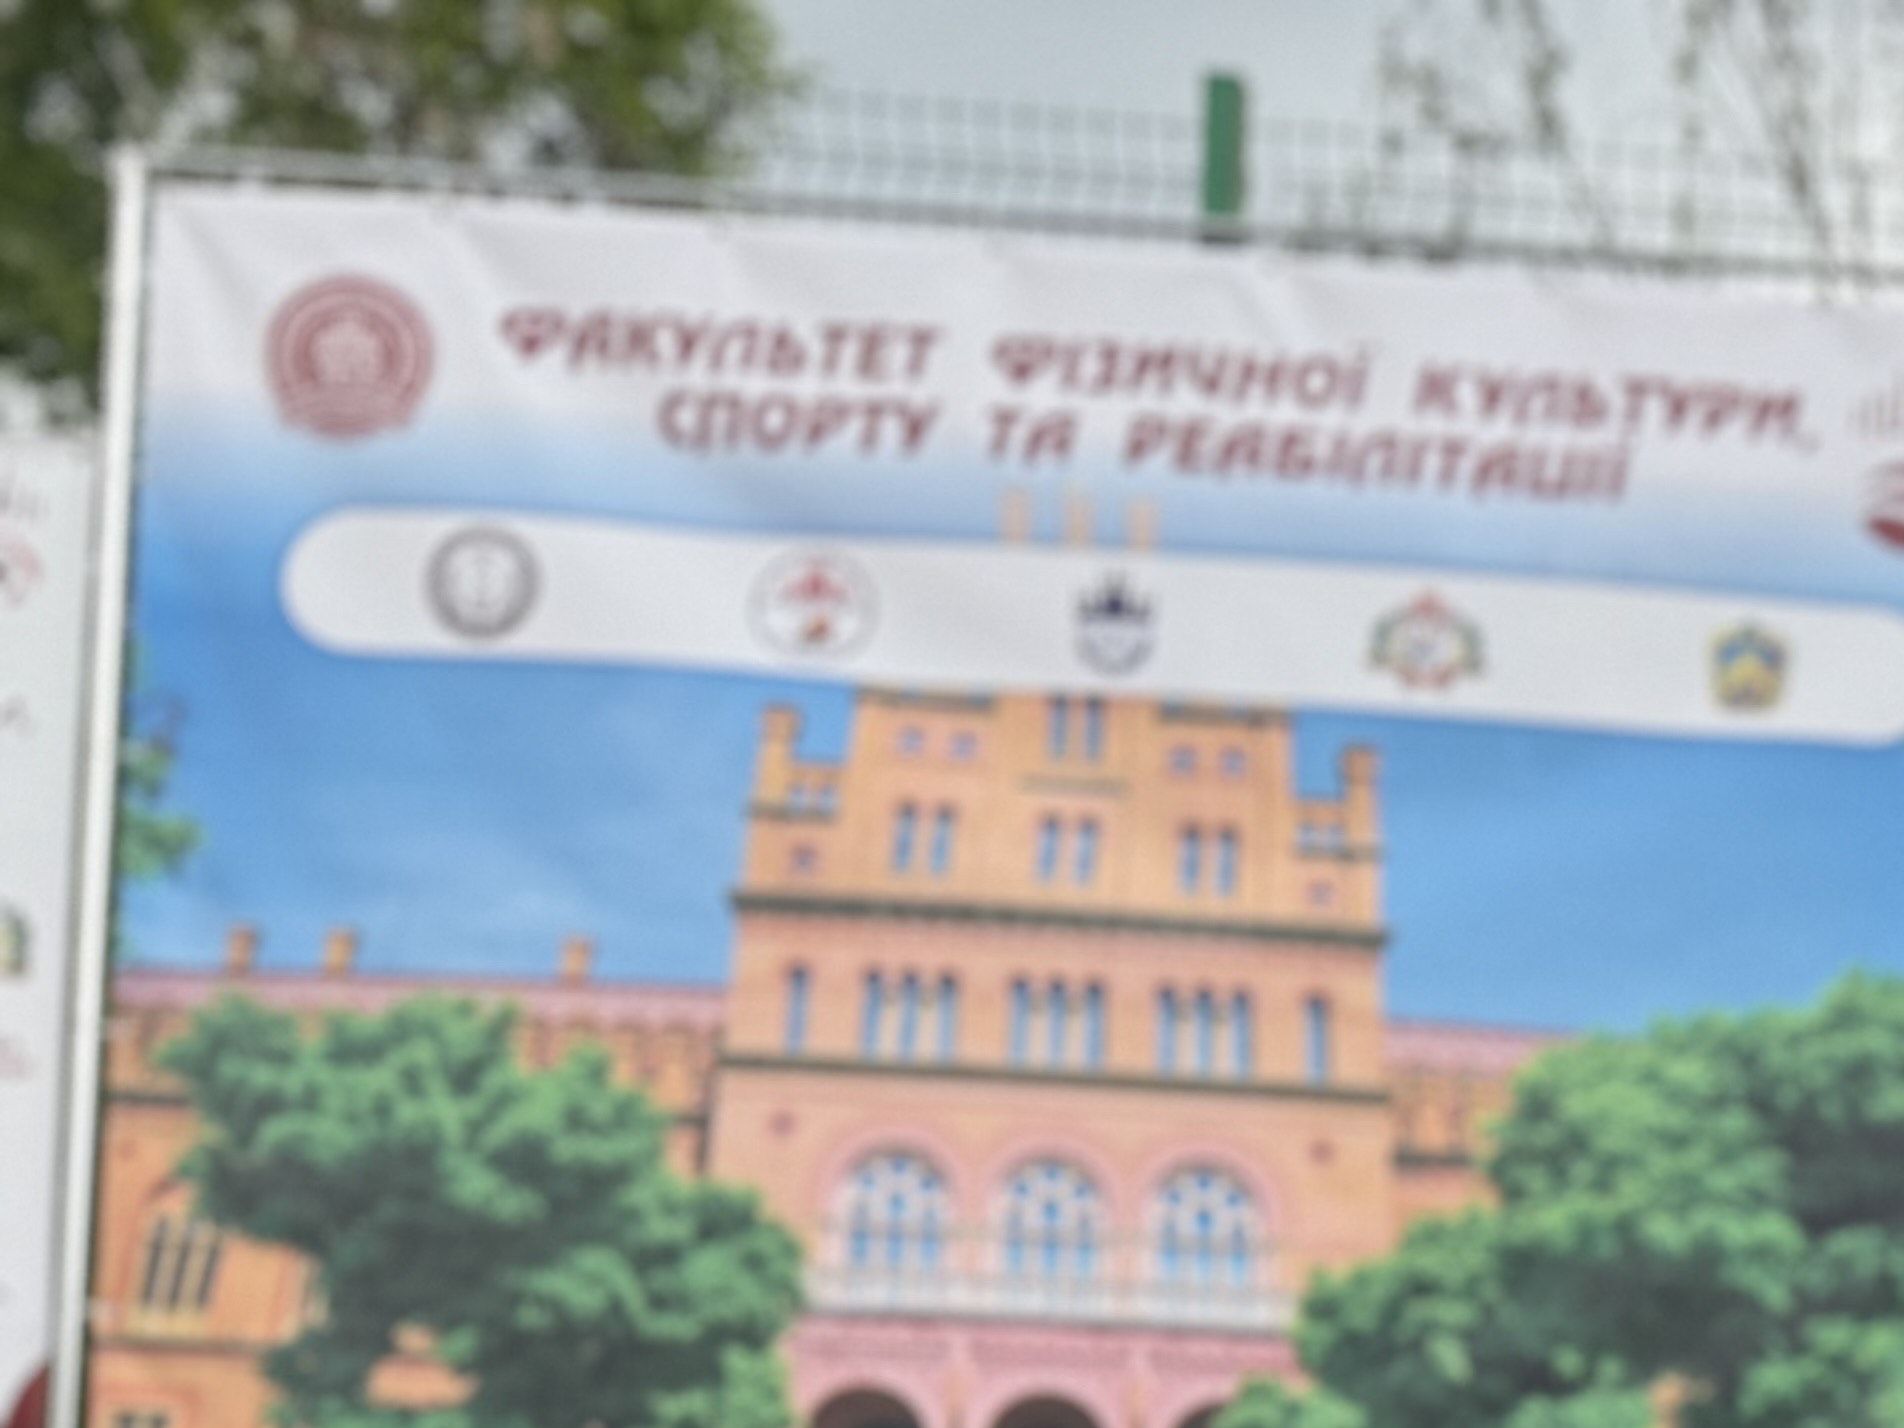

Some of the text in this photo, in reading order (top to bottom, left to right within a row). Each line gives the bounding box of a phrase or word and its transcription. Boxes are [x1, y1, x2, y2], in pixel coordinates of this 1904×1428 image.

[499, 307, 940, 382] ФАКУЛЬТЕТ
[990, 331, 1371, 414] ФІЗИЧНОЇ
[657, 389, 1630, 504] СПОРТУ ТА РЕАБІЛІТАЦІЇ
